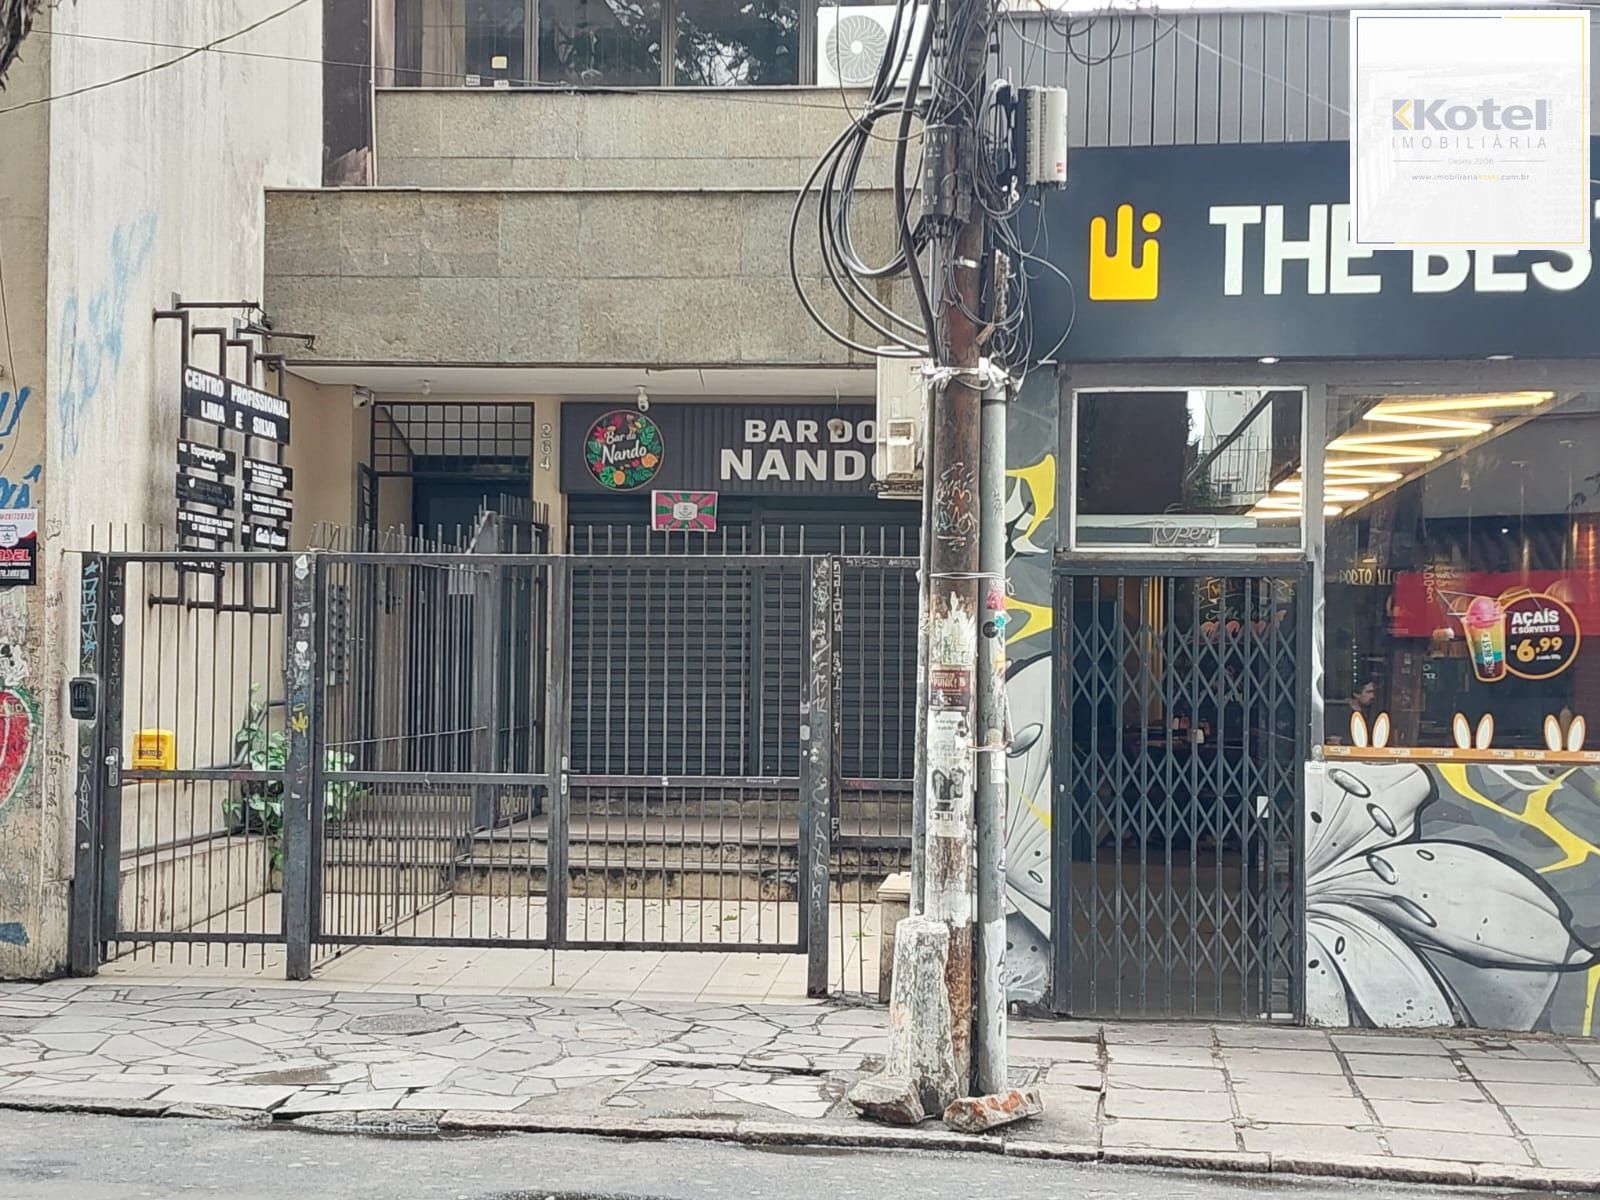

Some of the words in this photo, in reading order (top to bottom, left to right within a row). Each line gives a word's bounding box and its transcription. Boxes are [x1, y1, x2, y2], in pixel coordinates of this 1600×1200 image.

[1208, 203, 1382, 297] THE
[184, 368, 225, 398] CENTRO
[231, 383, 289, 418] PROFISSIONAL
[200, 399, 226, 424] LIMA
[234, 410, 244, 430] E
[251, 416, 278, 440] SILVA
[744, 419, 819, 444] BAR
[829, 419, 878, 444] DO
[604, 430, 626, 445] Bar
[626, 431, 637, 441] do
[602, 440, 647, 465] Nando
[720, 447, 878, 482] NAND
[1511, 607, 1560, 627] AÇAÍS
[1511, 626, 1518, 634] E
[1518, 624, 1561, 634] SORVETES
[1516, 636, 1563, 663] 6,99
